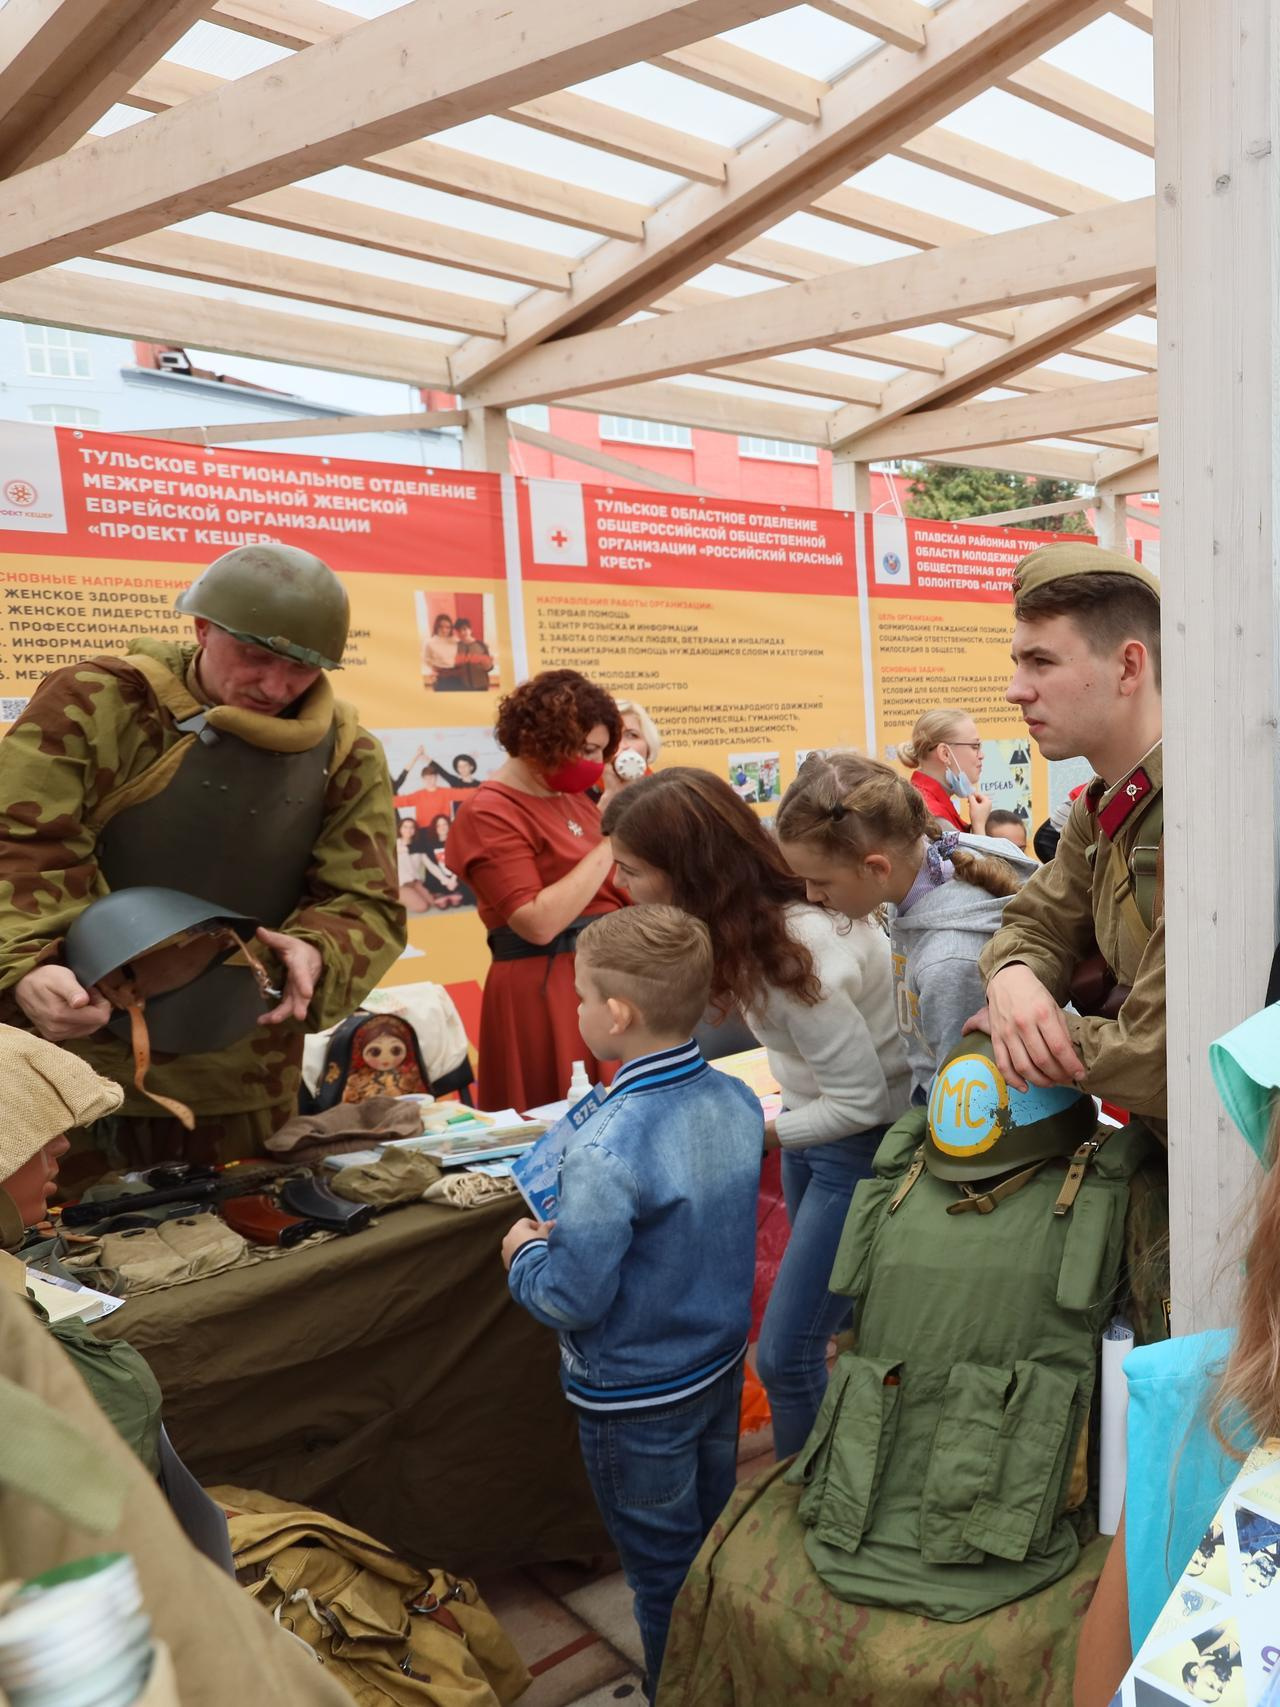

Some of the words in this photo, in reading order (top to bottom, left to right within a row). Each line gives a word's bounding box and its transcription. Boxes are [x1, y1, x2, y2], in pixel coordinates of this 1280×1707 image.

[78, 448, 198, 475] ТУЛЬСКОЕ
[203, 462, 365, 491] РЕГИОНАЛЬНОЕ
[369, 478, 477, 500] ОТДЕЛЕНИЕ
[82, 473, 308, 507] МЕЖРЕГИОНАЛЬНОЙ
[313, 493, 408, 515] ЖЕНСКОЙ
[85, 497, 220, 523] ЕВРЕЙСКОЙ
[226, 509, 370, 533] ОРГАНИЗАЦИИ
[595, 498, 668, 517] ТУЛЬСКОЕ
[671, 506, 746, 525] ОБЛАСТНОЕ
[749, 514, 817, 531] ОТДЕЛЕНИЕ
[88, 522, 188, 543] «ПРОЕКТ
[597, 518, 726, 540] ОБЩЕРОССИЙСКОЙ
[729, 529, 826, 548] ОБЩЕСТВЕННОЙ
[914, 530, 966, 545] ПЛАВСКАЯ
[968, 535, 1016, 549] РАЙОННАЯ
[598, 537, 696, 556] ОРГАНИЗАЦИИ
[699, 545, 786, 562] «РОССИЙСКИЙ
[789, 551, 843, 566] КРАСНЫЙ
[916, 546, 960, 559] ОБЛАСТИ
[600, 555, 652, 570] КРЕСТ»
[917, 561, 994, 577] ОБЩЕСТВЕННАЯ
[0, 571, 77, 585] СНОВНЫЕ
[918, 576, 979, 590] ВОЛОНТЕРОВ
[4, 588, 83, 601] ЖЕНСКОЕ
[89, 592, 168, 604] ЗДОРОВЬЕ
[7, 605, 86, 617] ЖЕНСКОЕ
[92, 607, 182, 620] ЛИДЕРСТВО
[547, 608, 586, 617] ПЕРВАЯ
[588, 610, 630, 619] ПОМОЩЬ
[9, 621, 178, 635] ПРОФЕССИОНАЛЬНАЯ
[548, 621, 581, 630] ЦЕНТР
[582, 622, 627, 631] РОЗЫСКА
[637, 623, 698, 633] ИНФОРМАЦИИ
[550, 634, 586, 642] ЗАБОТА
[596, 634, 643, 643] ПОЖИЛЫХ
[681, 636, 729, 645] ВЕТЕРАНАХ
[738, 637, 785, 646] ИНВАЛИДАХ
[550, 646, 626, 655] ГУМАНИТАРНАЯ
[628, 647, 668, 656] ПОМОЩЬ
[669, 648, 741, 657] НУЖДАЮЩИМСЯ
[742, 648, 769, 656] СЛОЯМ
[777, 648, 824, 657] КАТЕГОРИЯМ
[541, 658, 600, 667] НАСЕЛЕНИЯ
[599, 670, 660, 679] МОЛОДЕЖЬЮ
[636, 682, 688, 691] ДОНОРСТВО
[651, 704, 702, 714] ПРИНЦИПЫ
[703, 703, 779, 713] МЕЖДУНАРОДНОГО
[780, 702, 823, 711] ДВИЖЕНИЯ
[572, 1099, 600, 1126] 875
